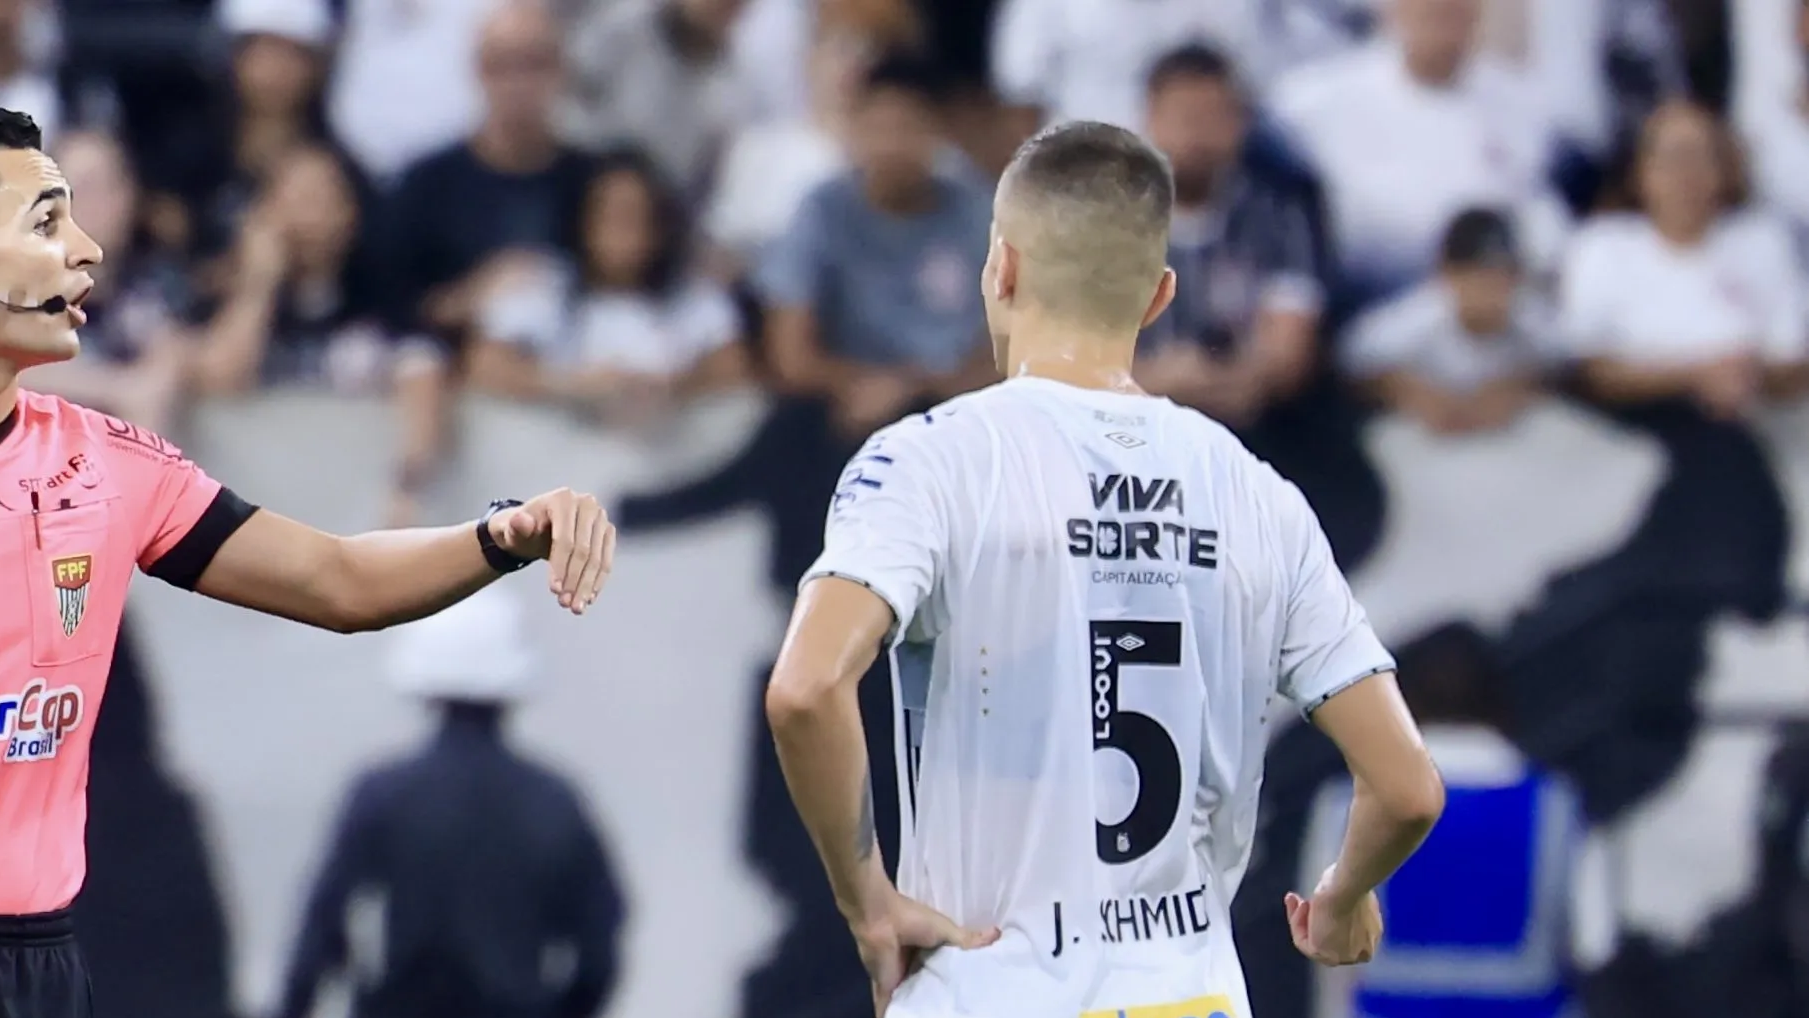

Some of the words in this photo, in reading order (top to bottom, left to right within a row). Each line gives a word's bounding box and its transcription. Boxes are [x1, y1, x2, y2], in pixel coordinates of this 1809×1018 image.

[1087, 472, 1184, 517] VIVA
[1066, 518, 1218, 570] SORTE
[56, 561, 88, 583] FPF
[1089, 620, 1182, 865] 5
[1052, 902, 1080, 958] J.
